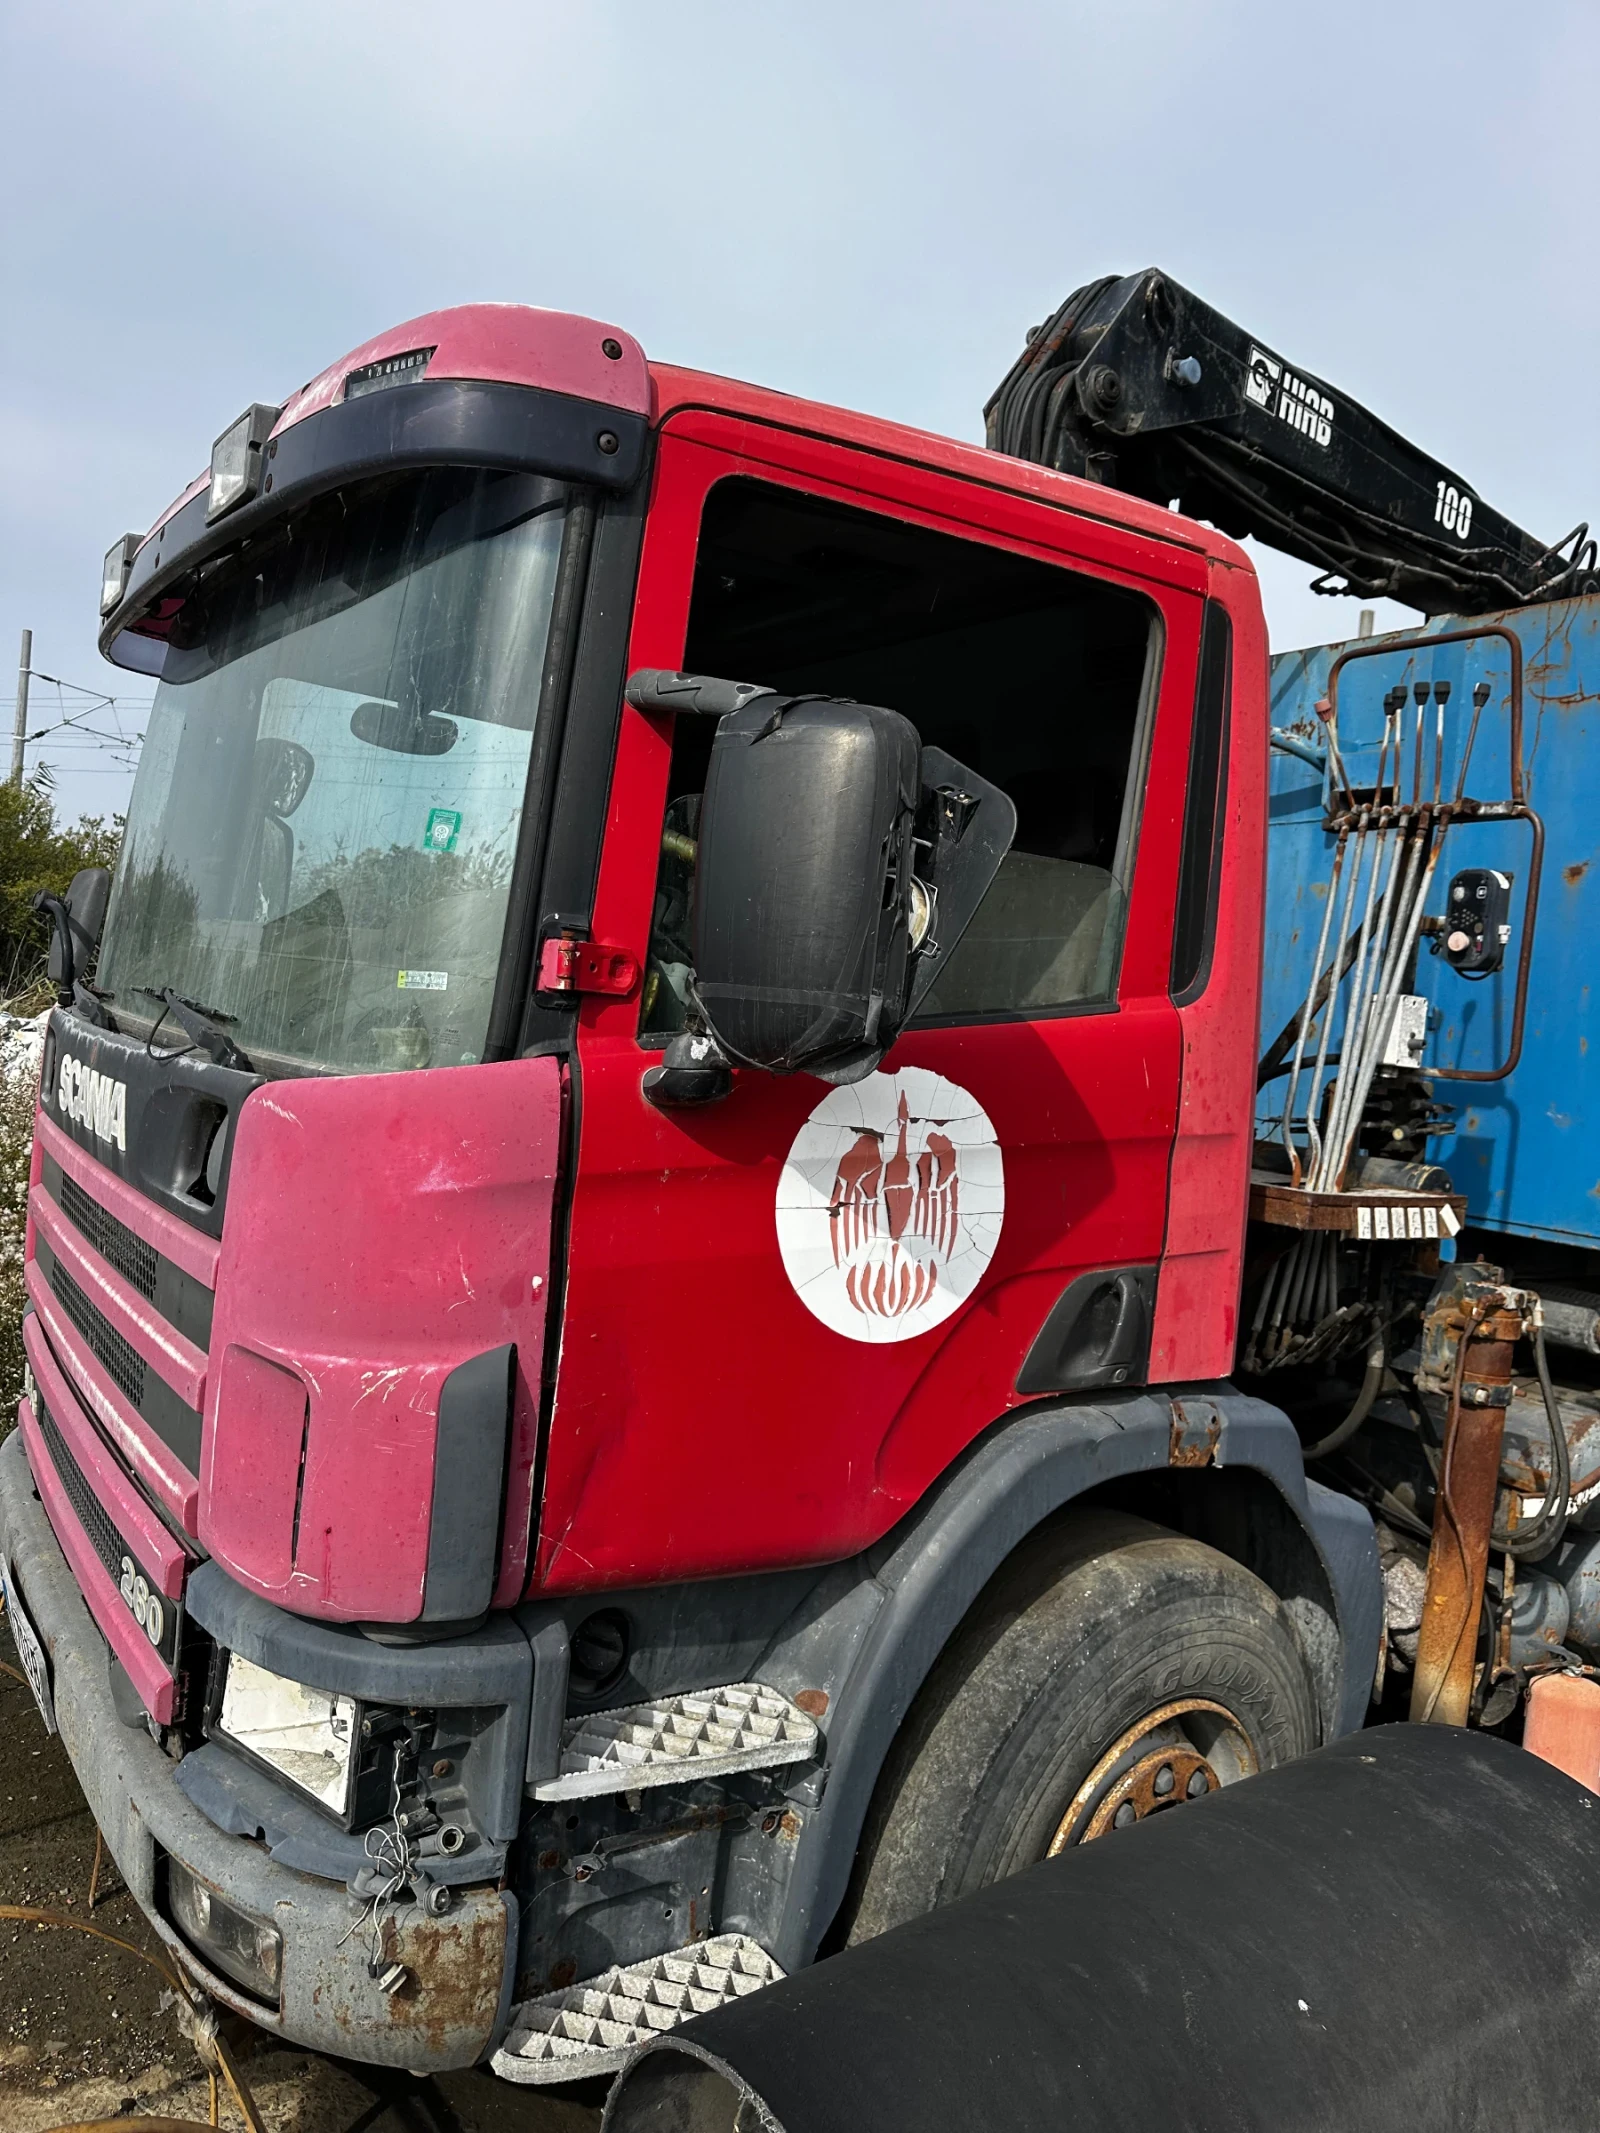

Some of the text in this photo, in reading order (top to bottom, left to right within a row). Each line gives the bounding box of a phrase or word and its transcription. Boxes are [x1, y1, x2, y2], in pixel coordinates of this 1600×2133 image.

[1434, 480, 1473, 540] 100
[58, 1053, 127, 1151] SCANIA
[120, 1555, 164, 1646] 260
